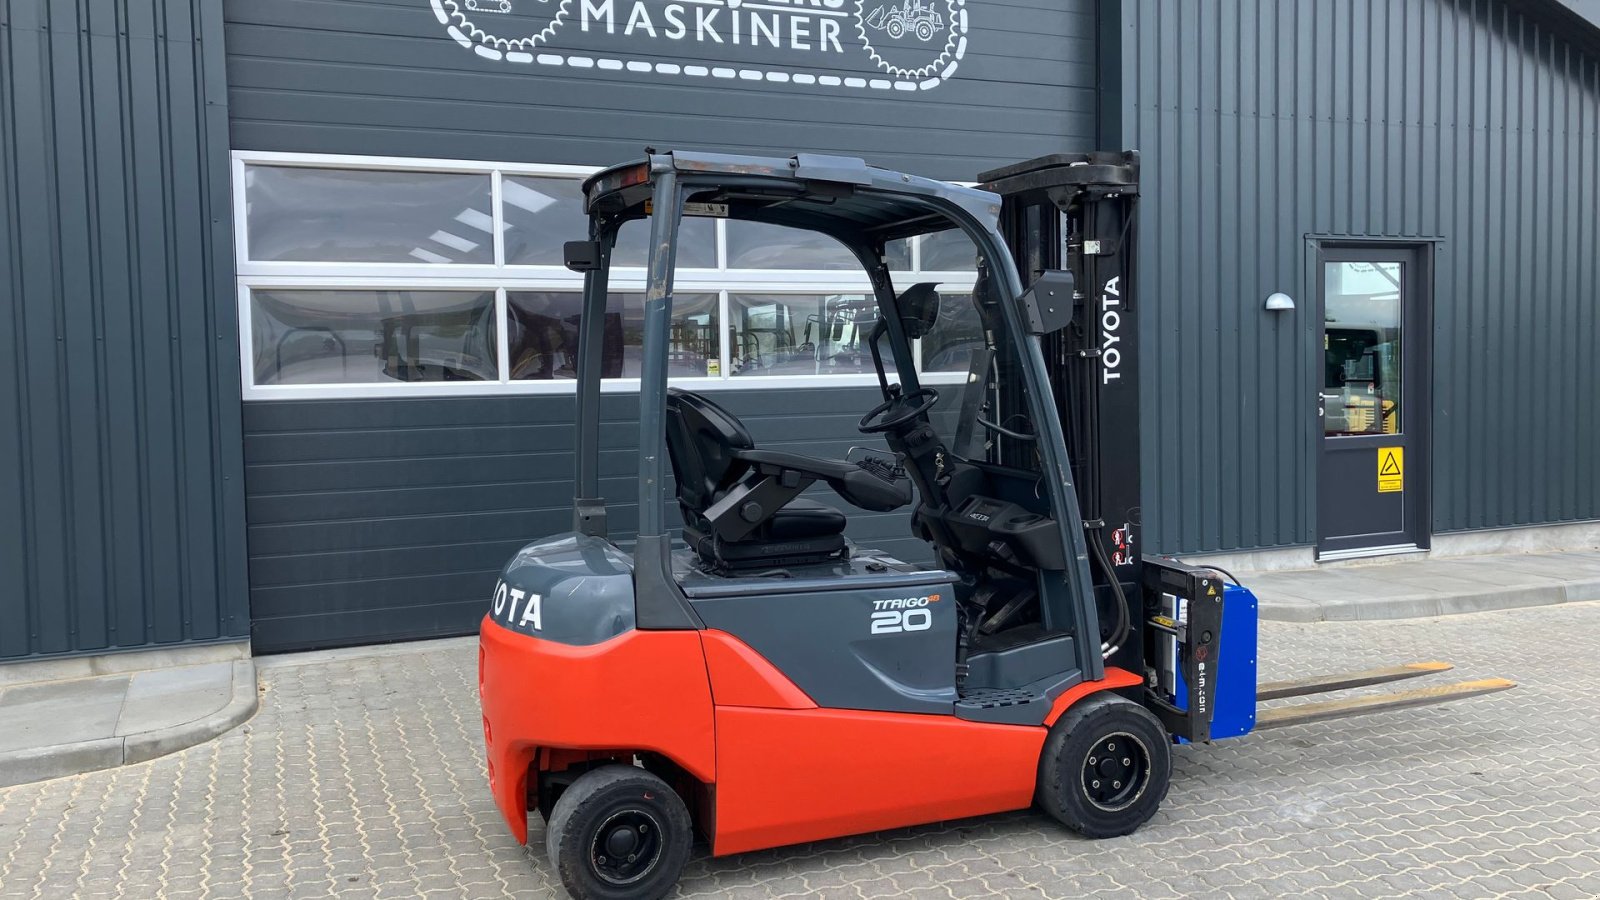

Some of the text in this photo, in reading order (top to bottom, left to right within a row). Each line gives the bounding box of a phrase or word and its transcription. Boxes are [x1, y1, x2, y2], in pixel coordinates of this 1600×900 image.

[580, 1, 844, 53] MASKINER
[1102, 275, 1121, 385] TOYOTA
[492, 578, 542, 630] OTA
[871, 608, 932, 634] 20
